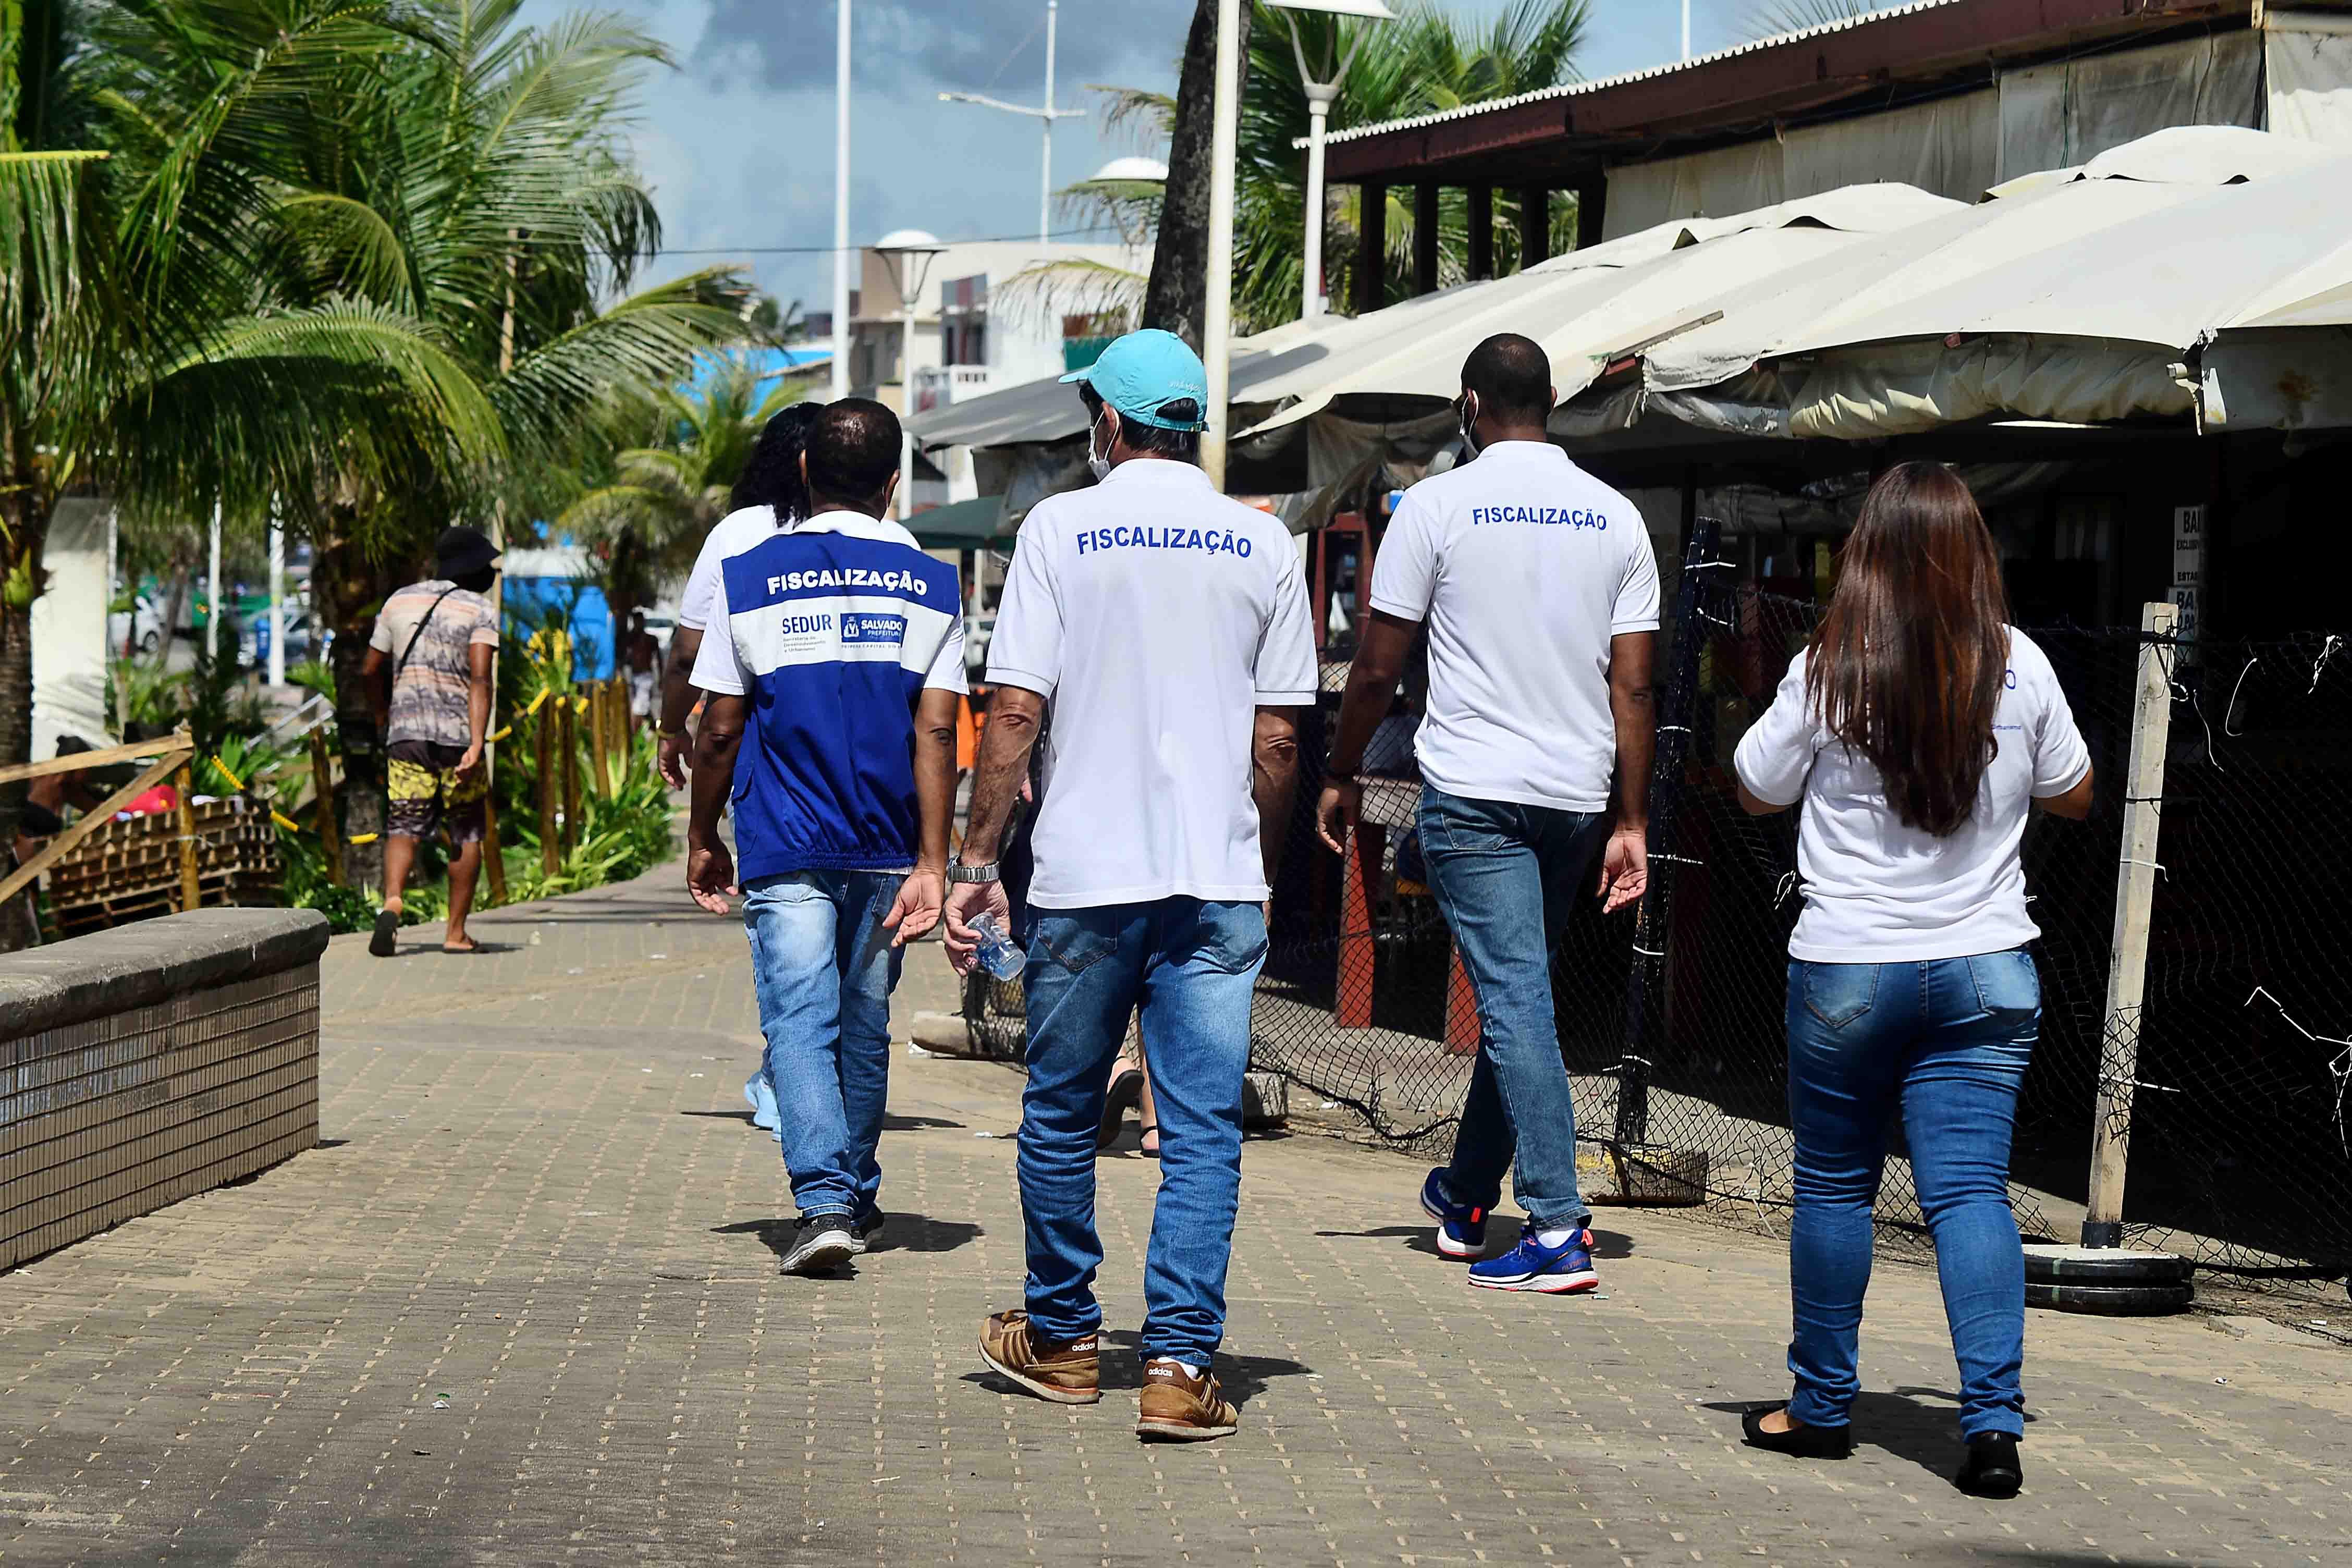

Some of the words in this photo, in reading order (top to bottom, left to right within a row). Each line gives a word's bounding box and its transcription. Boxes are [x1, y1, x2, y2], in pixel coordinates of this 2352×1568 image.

[1473, 507, 1607, 530] FISCALIZAÇÃO
[1077, 526, 1252, 558] FISCALIZAÇÃO
[767, 568, 928, 596] FISCALIZAÇÃO
[782, 614, 832, 634] SEDUR
[861, 619, 902, 631] SALVADO
[1148, 1367, 1173, 1377] adidas
